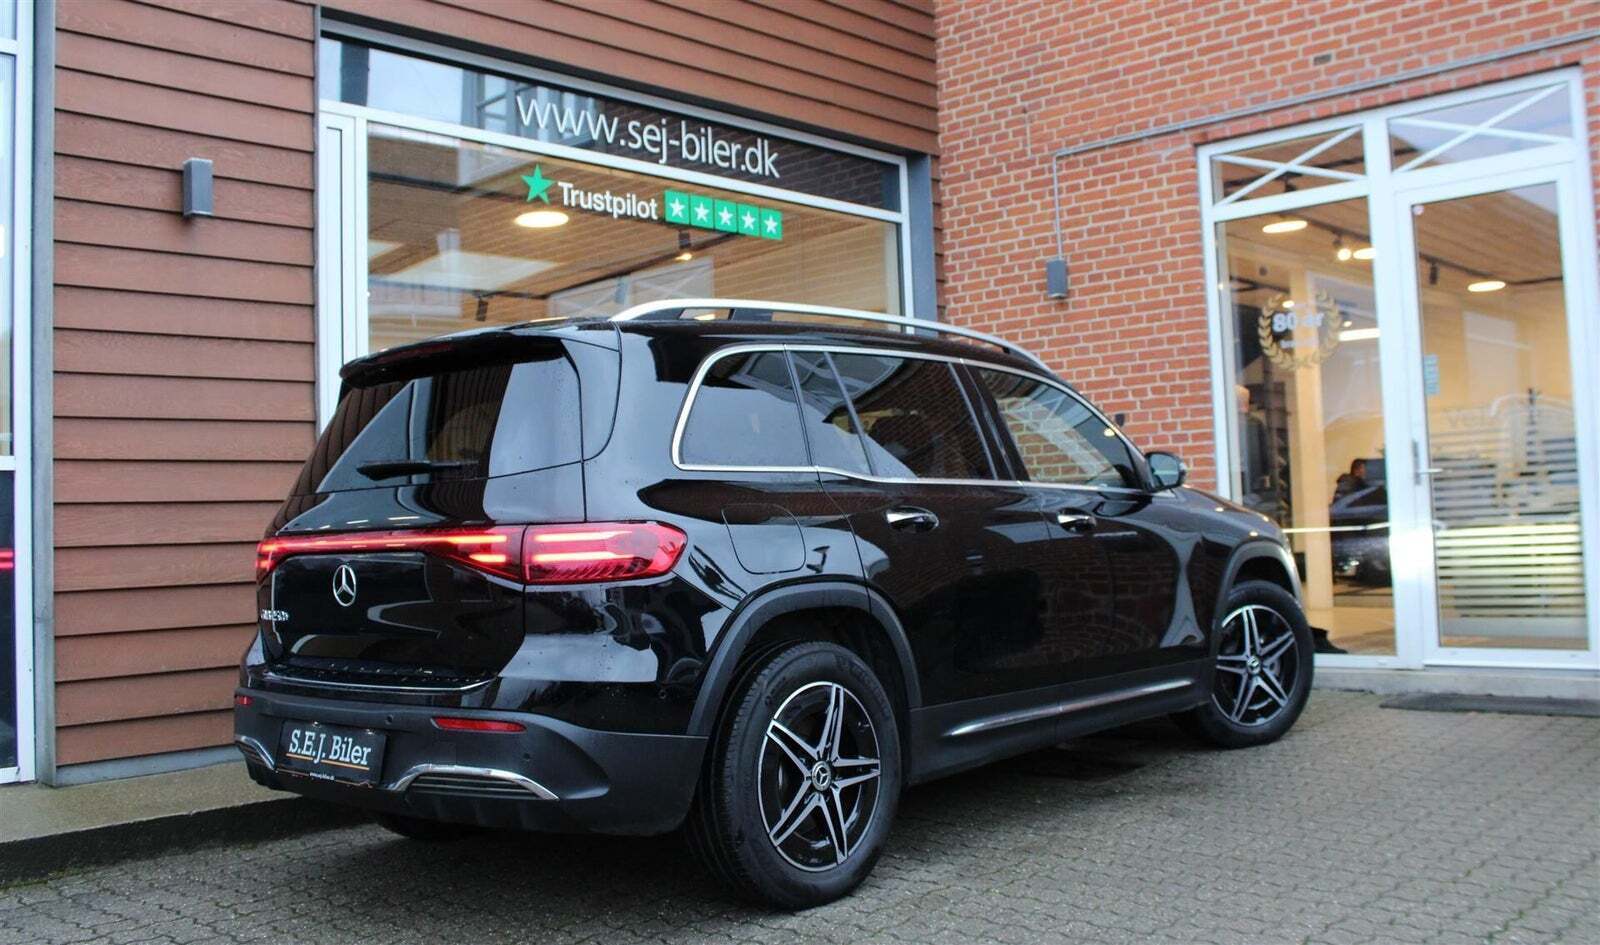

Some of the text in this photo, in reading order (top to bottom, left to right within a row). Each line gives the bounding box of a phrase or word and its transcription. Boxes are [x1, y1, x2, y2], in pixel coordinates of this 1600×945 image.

[517, 95, 780, 178] www.sej-biler.dk
[558, 181, 658, 220] Trustpilot
[289, 729, 372, 766] S.E.J. Biler
